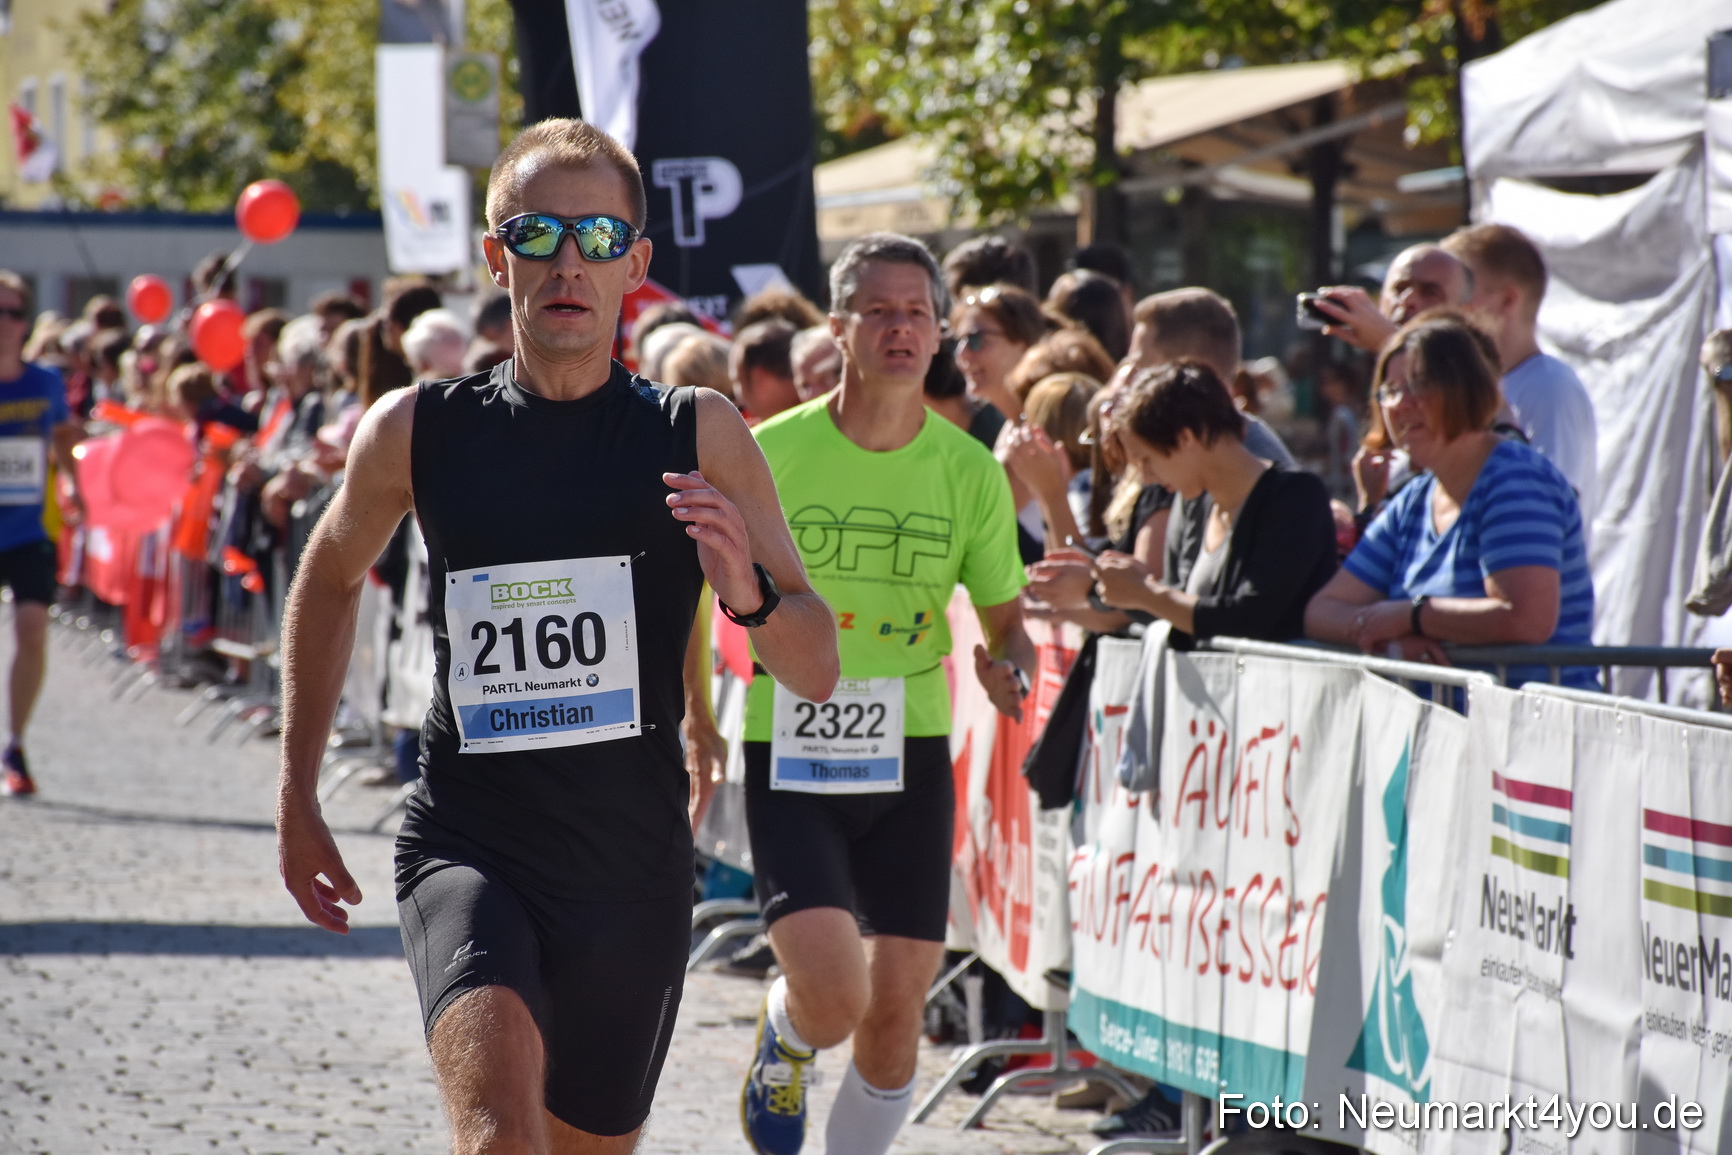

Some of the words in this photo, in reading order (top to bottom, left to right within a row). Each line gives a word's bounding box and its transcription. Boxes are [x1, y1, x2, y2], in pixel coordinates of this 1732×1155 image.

[491, 578, 575, 603] BOCK
[491, 602, 515, 611] inspired
[526, 600, 546, 608] smart
[547, 598, 577, 607] concepts
[471, 611, 607, 676] 2160
[482, 682, 522, 695] PARTL
[525, 677, 582, 692] Neumarkt
[490, 703, 594, 732] Christian
[795, 702, 886, 739] 2322
[810, 761, 870, 779] Thomas
